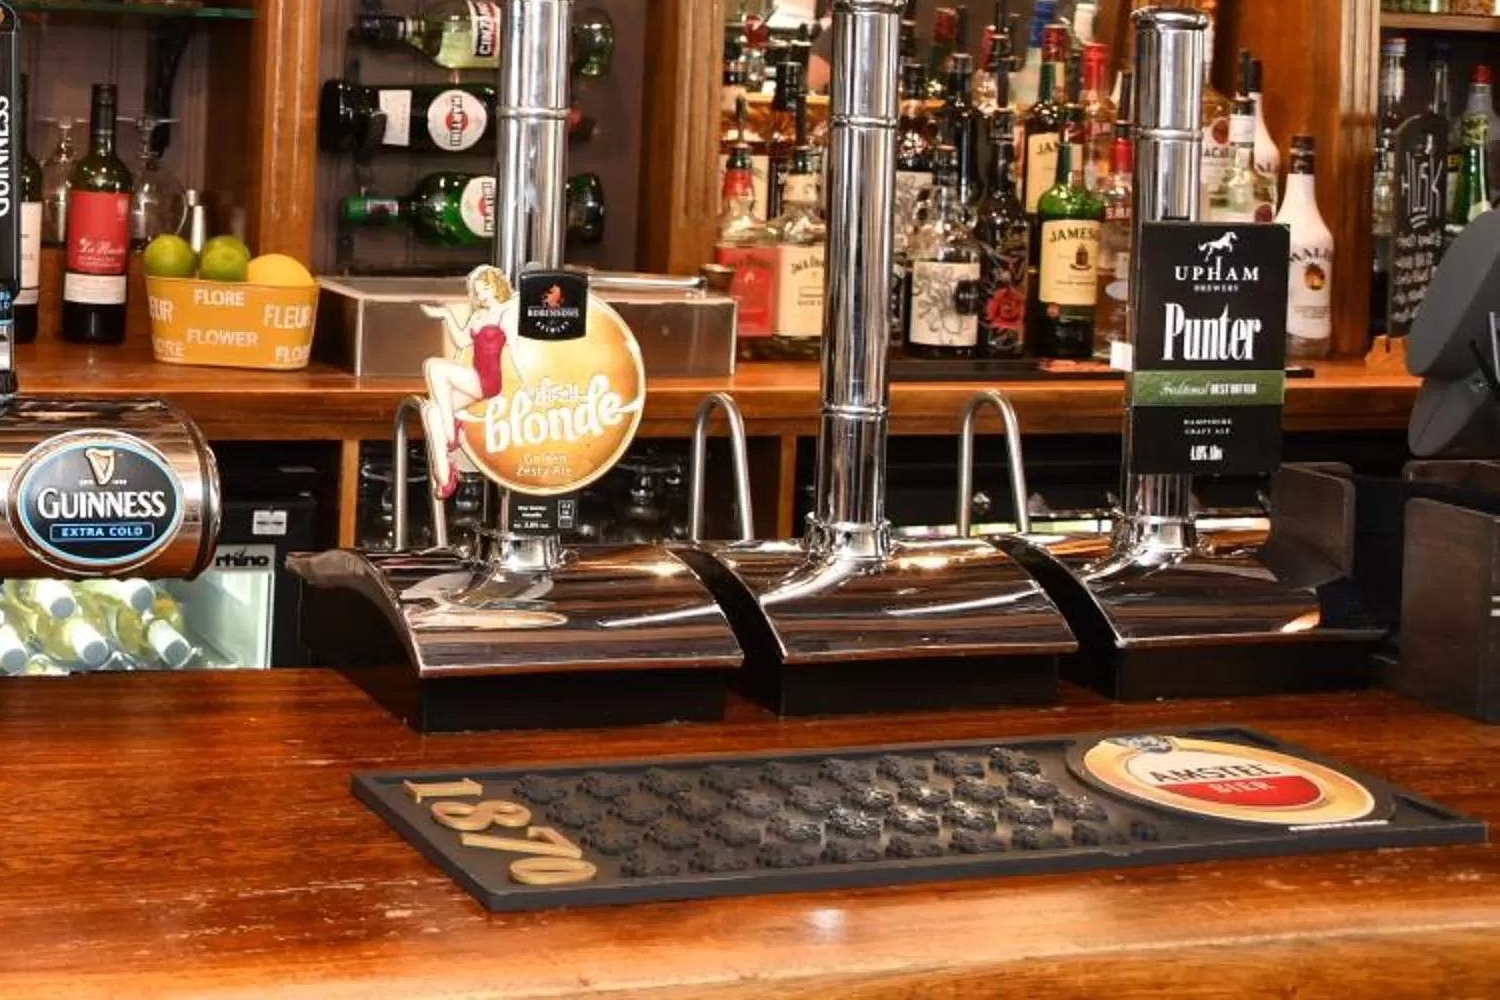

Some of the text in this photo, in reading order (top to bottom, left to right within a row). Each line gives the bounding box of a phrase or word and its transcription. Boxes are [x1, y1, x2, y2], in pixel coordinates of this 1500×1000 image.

[451, 95, 463, 147] MARTINI
[1175, 256, 1260, 281] UPHAM
[194, 289, 245, 307] FLORE
[186, 328, 260, 348] FLOWER
[1161, 302, 1262, 361] Punter
[484, 375, 622, 453] blonde
[37, 487, 167, 519] GUINNESS
[60, 526, 143, 538] EXTRA COLD
[1149, 763, 1282, 783] AMSTEL
[1208, 779, 1278, 794] BIER
[403, 777, 597, 885] 1870
